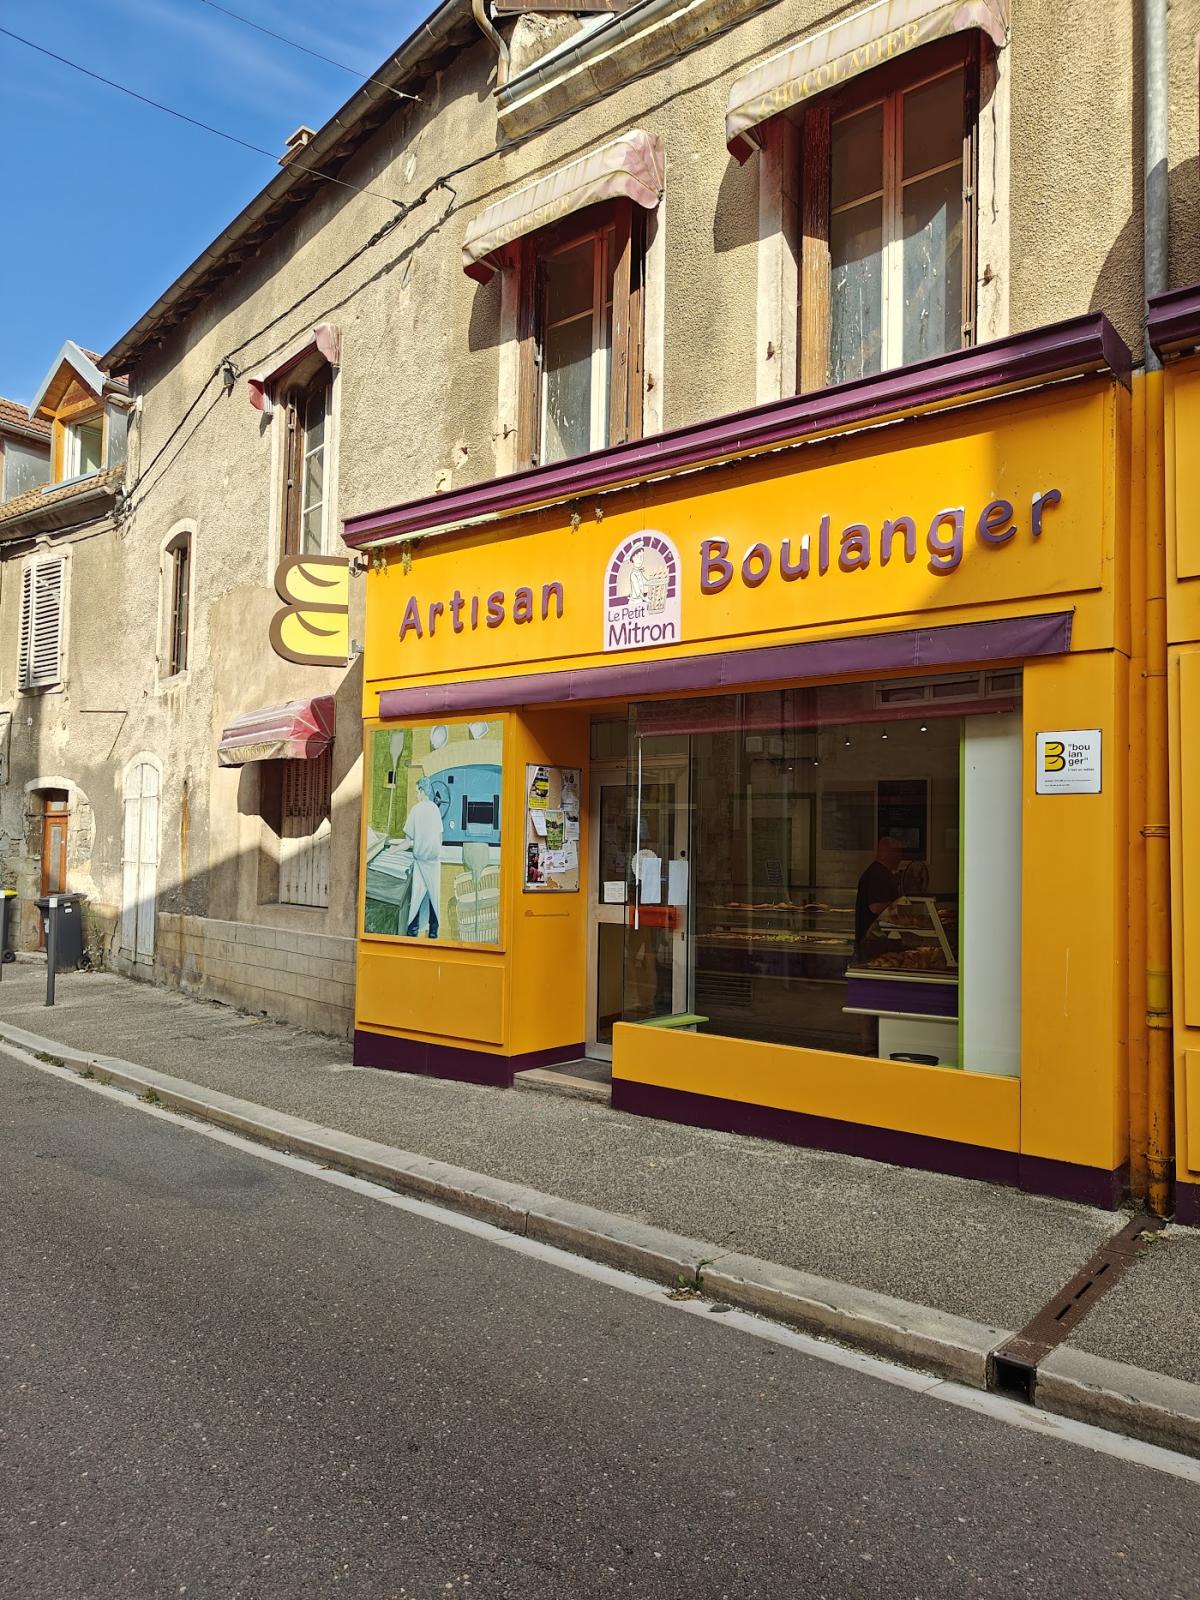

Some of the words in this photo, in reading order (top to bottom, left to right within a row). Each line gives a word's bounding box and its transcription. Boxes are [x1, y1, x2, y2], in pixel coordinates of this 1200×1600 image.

[760, 23, 920, 109] CHOCOLATIER
[699, 489, 1063, 595] Boulanger
[399, 578, 564, 641] Artisan
[608, 611, 620, 622] Le
[622, 606, 645, 621] Petit
[608, 621, 675, 647] Mitron
